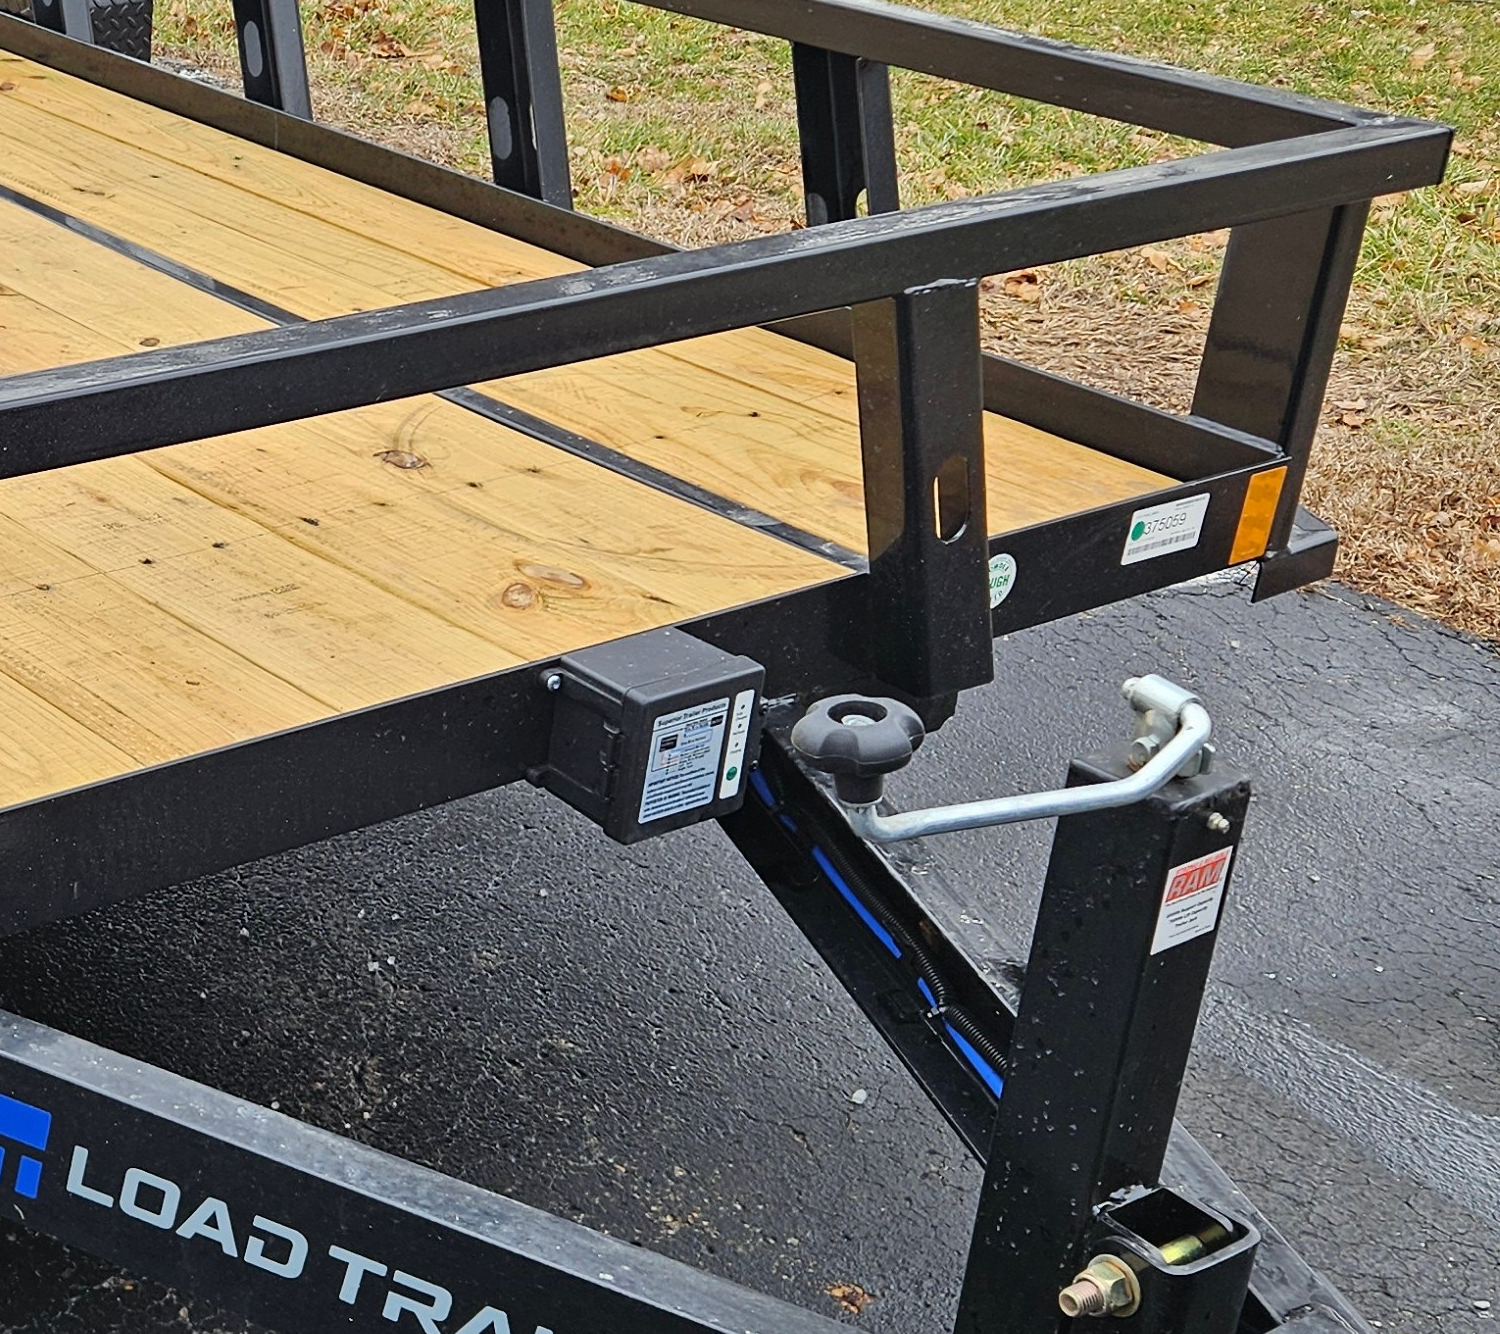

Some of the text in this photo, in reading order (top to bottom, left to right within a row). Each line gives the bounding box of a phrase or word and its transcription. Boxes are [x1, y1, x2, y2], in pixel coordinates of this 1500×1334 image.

[989, 575, 1010, 589] UGH
[1167, 859, 1227, 900] RAM
[66, 1146, 308, 1278] LOAD
